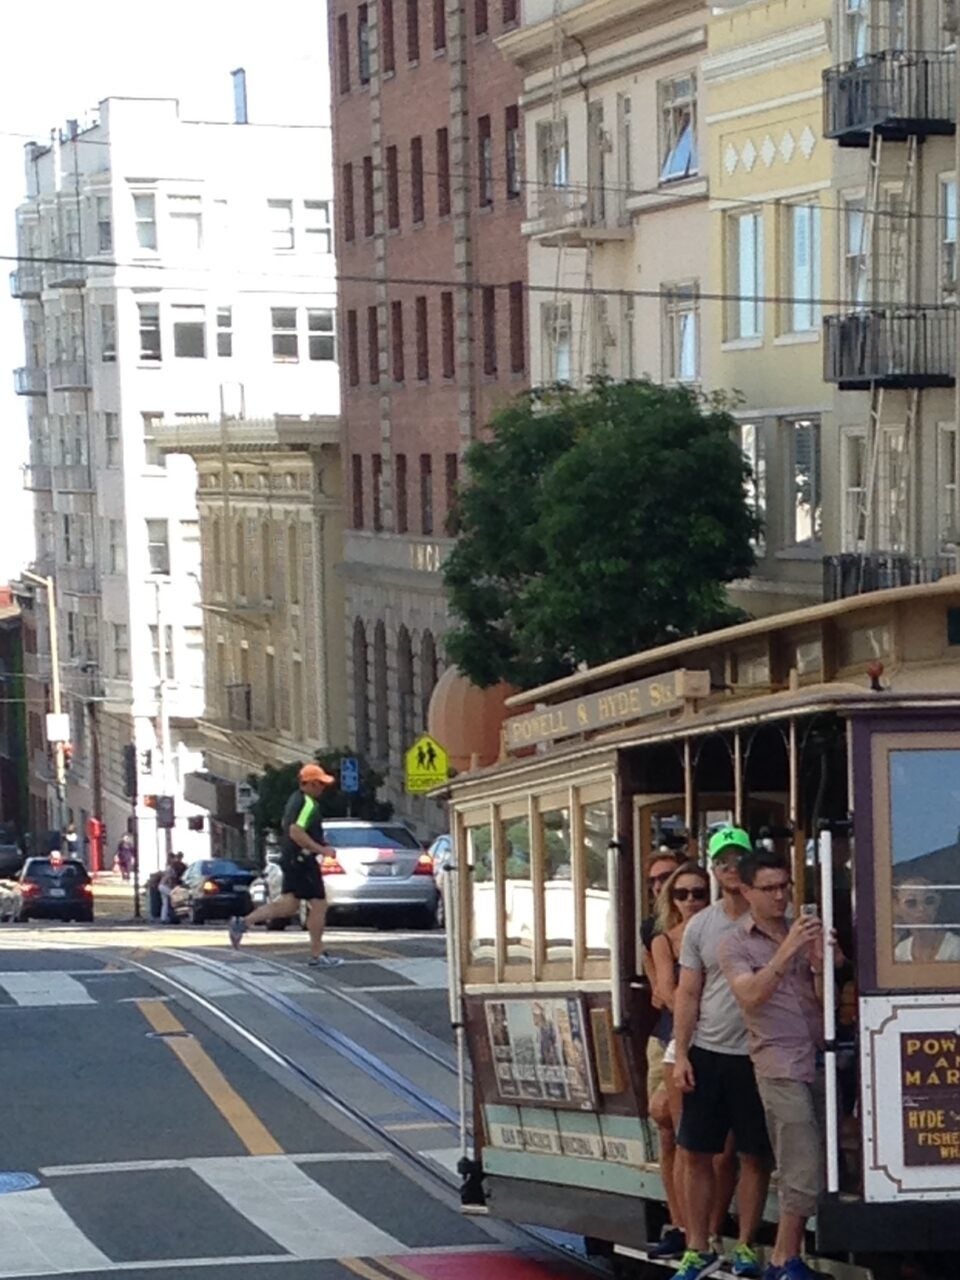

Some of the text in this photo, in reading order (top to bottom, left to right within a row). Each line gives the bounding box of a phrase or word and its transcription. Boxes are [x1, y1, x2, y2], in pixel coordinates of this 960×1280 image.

[511, 711, 569, 742] POWELL
[577, 703, 590, 727] &
[599, 688, 641, 720] HYDE
[908, 1110, 946, 1129] HYDE
